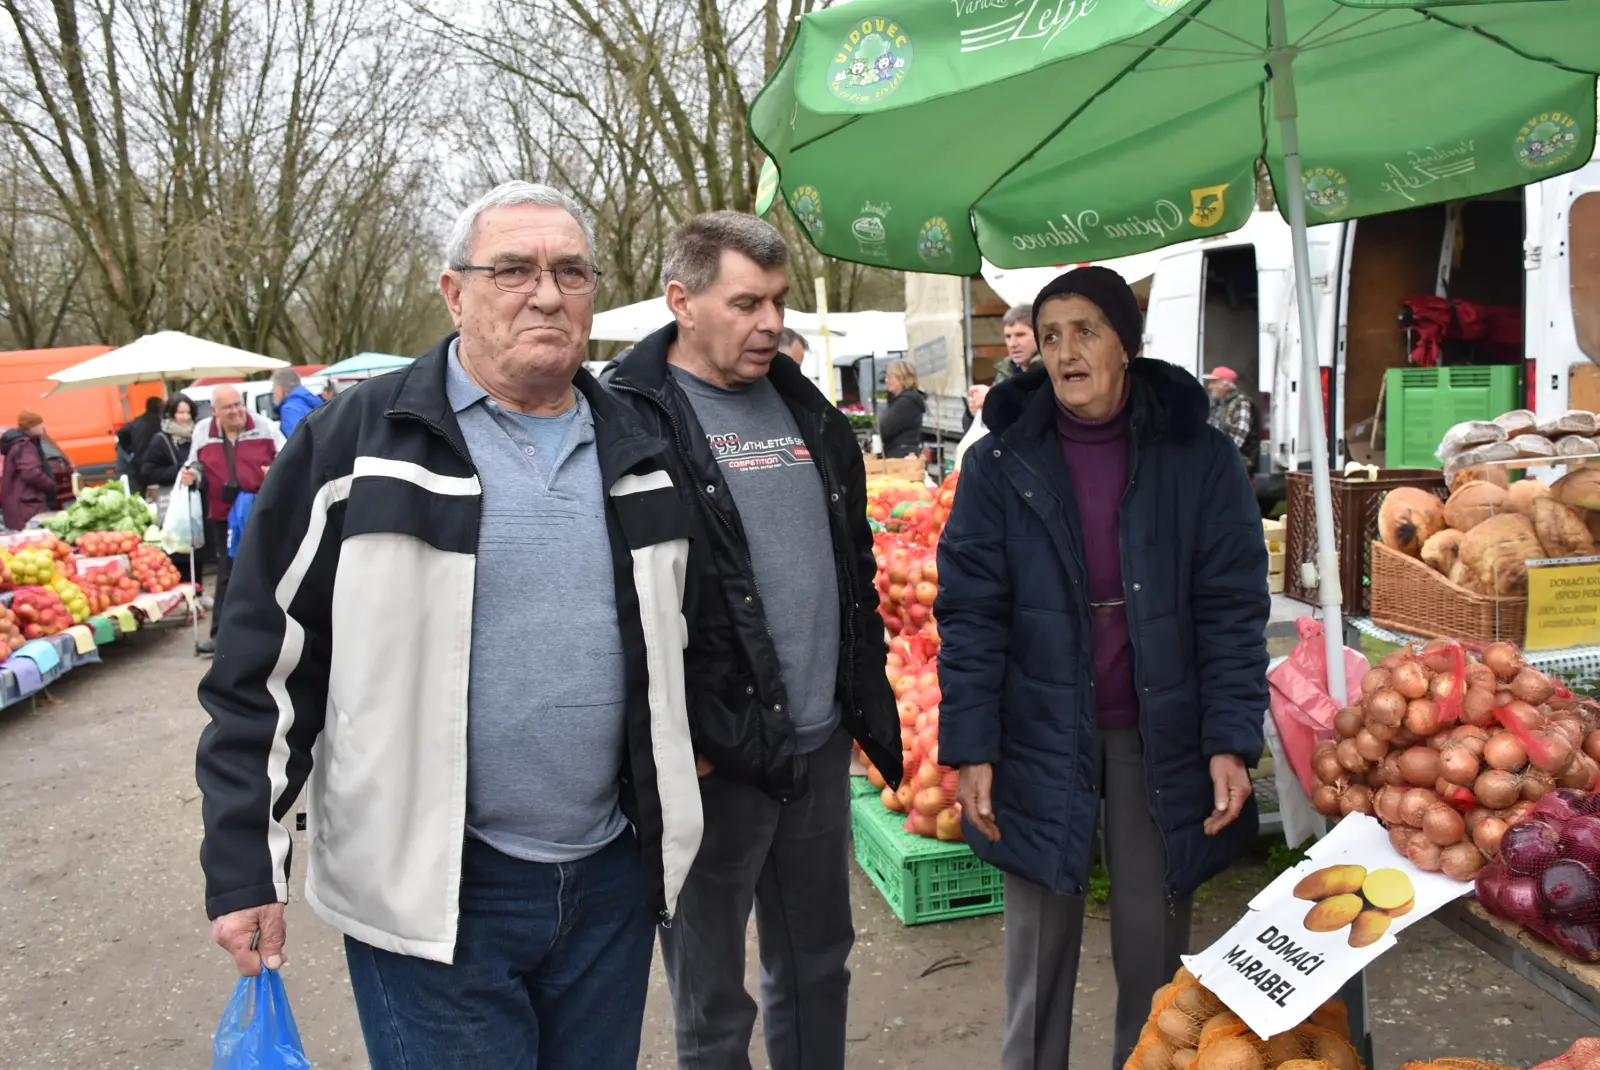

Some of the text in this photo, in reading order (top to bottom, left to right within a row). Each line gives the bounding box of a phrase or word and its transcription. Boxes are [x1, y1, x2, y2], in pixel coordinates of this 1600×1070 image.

[835, 18, 908, 63] VIDOVEC
[728, 456, 778, 469] COMPETITION
[1256, 925, 1325, 976] DOMAĆI
[1222, 944, 1296, 1008] MARABEL
